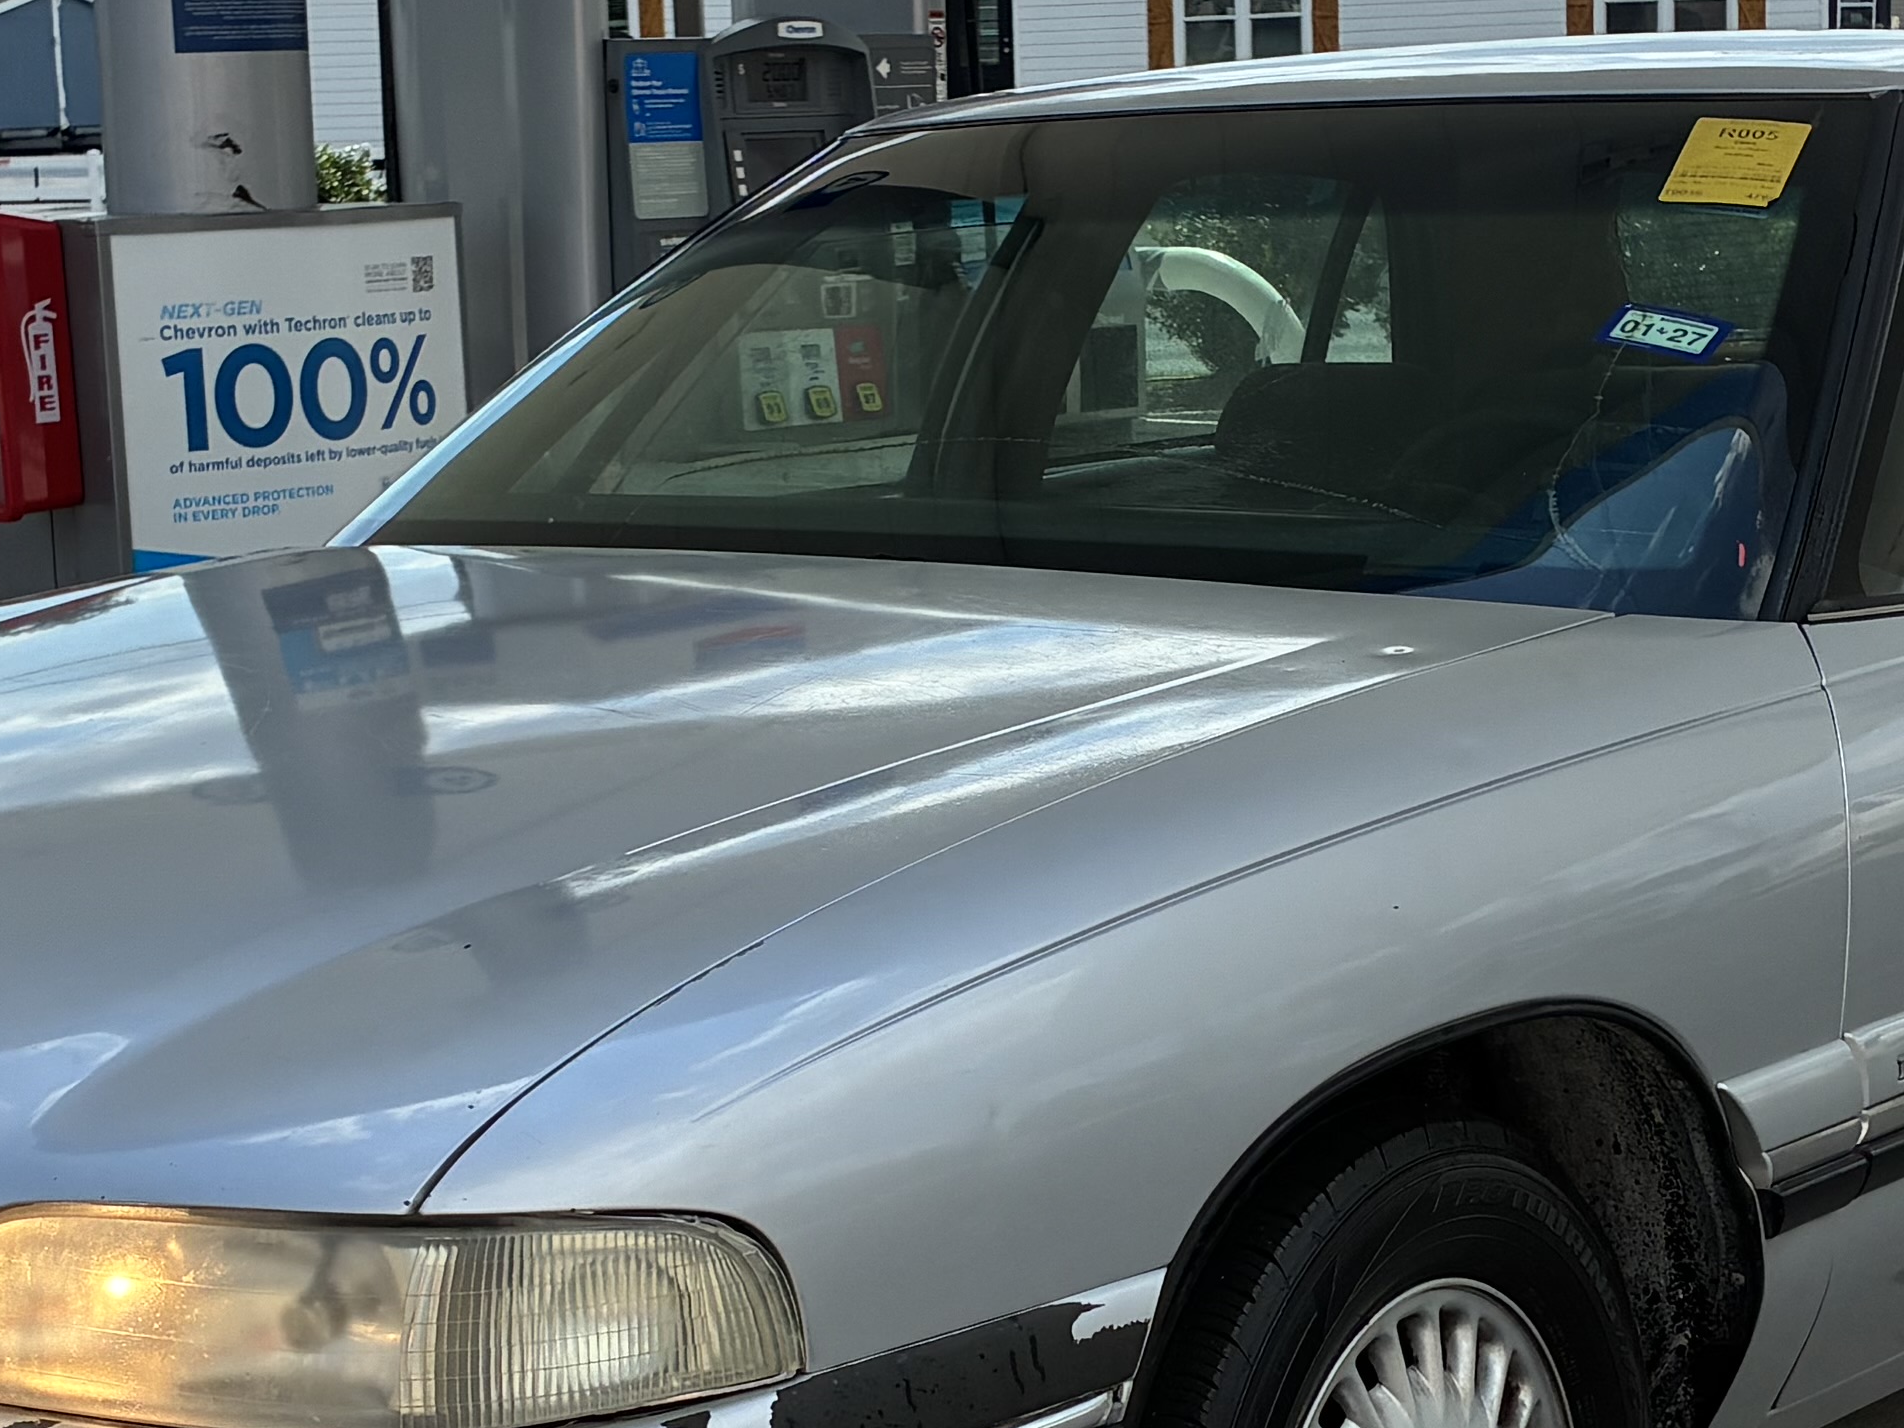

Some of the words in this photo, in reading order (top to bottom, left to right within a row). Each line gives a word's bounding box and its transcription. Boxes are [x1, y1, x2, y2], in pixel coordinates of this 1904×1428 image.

[159, 324, 237, 341] Chevron
[243, 318, 280, 335] with
[353, 311, 396, 328] cleans
[400, 310, 416, 326] up
[418, 307, 432, 322] to
[160, 300, 263, 321] NEXT-GEN
[1620, 319, 1656, 338] 01
[1665, 328, 1708, 347] 27
[33, 333, 57, 413] FIRE
[161, 334, 436, 453] 100%
[169, 461, 184, 475] of
[188, 456, 243, 474] harmful
[246, 451, 303, 470] deposits
[305, 449, 326, 463] left
[329, 448, 343, 462] by
[173, 493, 250, 510] ADVANCED
[253, 483, 334, 503] PROTECTION
[173, 512, 188, 523] IN
[192, 507, 238, 522] EVERY
